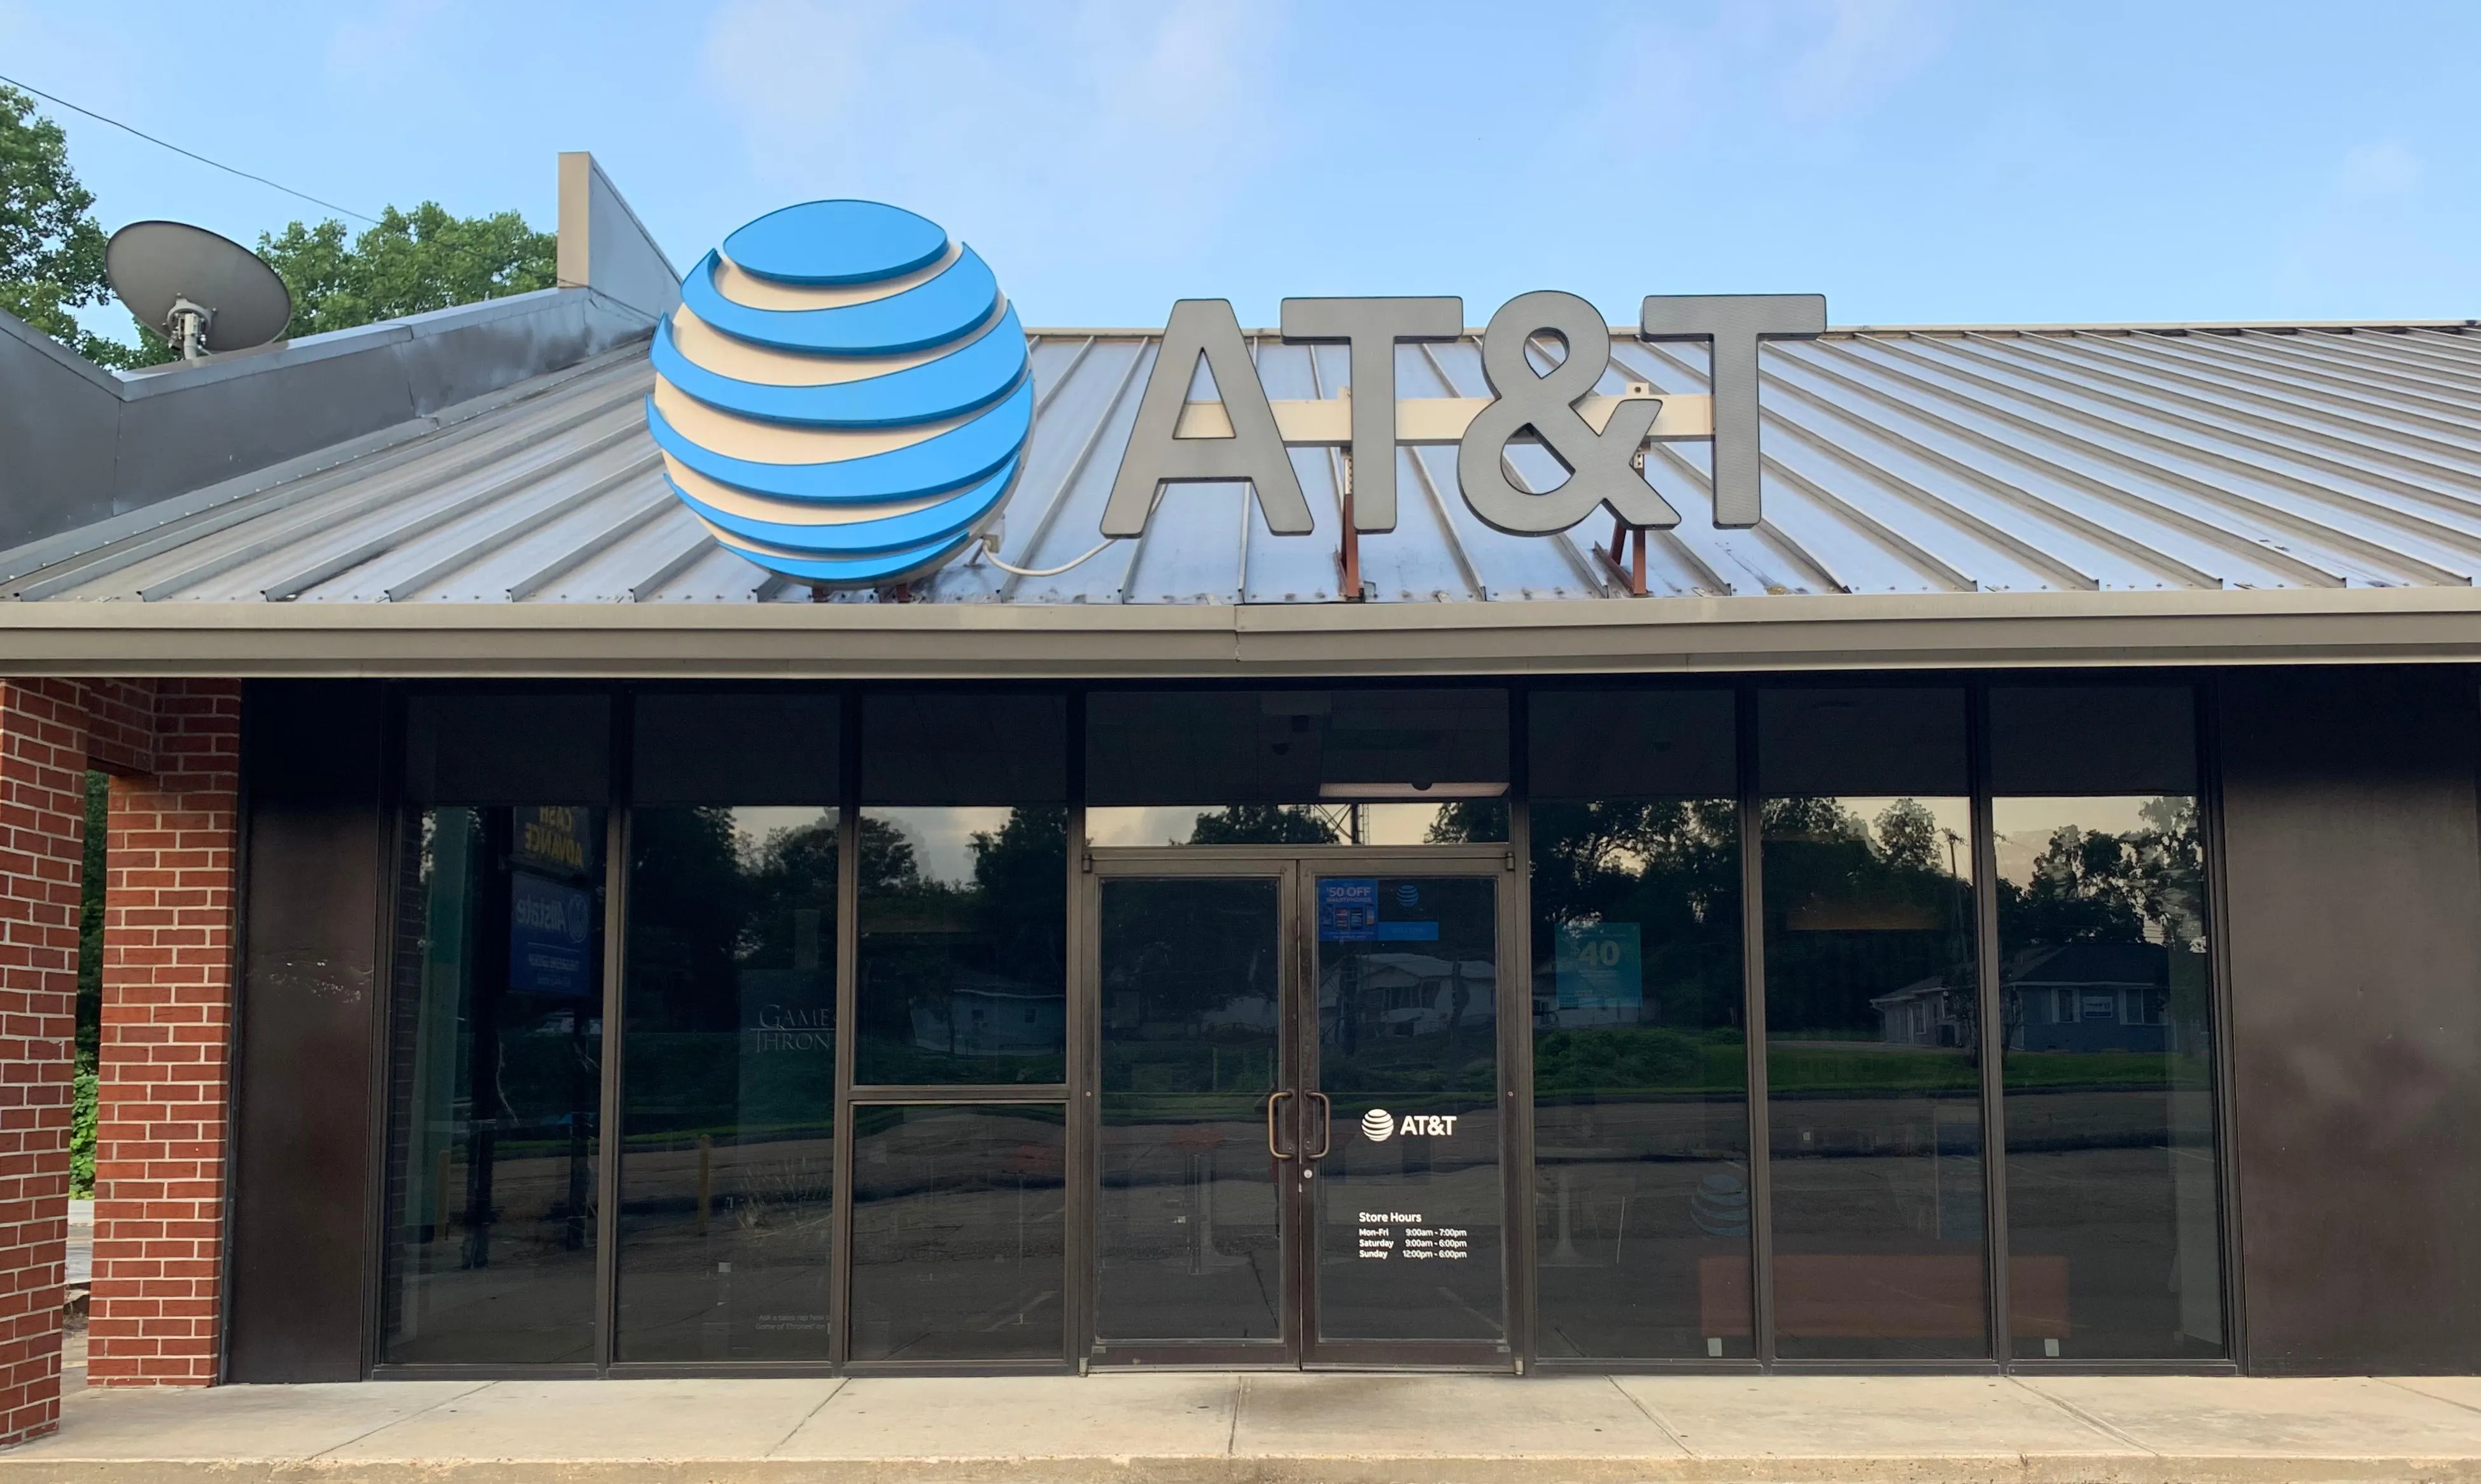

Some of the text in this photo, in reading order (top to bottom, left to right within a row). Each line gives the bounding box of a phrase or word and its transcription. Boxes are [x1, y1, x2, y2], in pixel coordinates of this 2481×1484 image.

[1099, 290, 1827, 538] AT&T
[1346, 886, 1372, 897] OFF
[759, 1004, 830, 1030] GAME
[750, 1028, 831, 1053] THRON
[1400, 1116, 1457, 1135] AT&T
[1359, 1212, 1422, 1222] Store Hours
[1359, 1228, 1389, 1237] Mon-Fri
[1405, 1228, 1433, 1237] 9:00am
[1439, 1228, 1467, 1239] 7:00pm
[1359, 1239, 1394, 1249] Saturday
[1405, 1239, 1433, 1247] 9:00am
[1439, 1239, 1467, 1249] 6:00pm
[1359, 1250, 1388, 1260] Sunday
[1402, 1250, 1433, 1260] 12:00pm
[1439, 1250, 1467, 1260] 6:00pm
